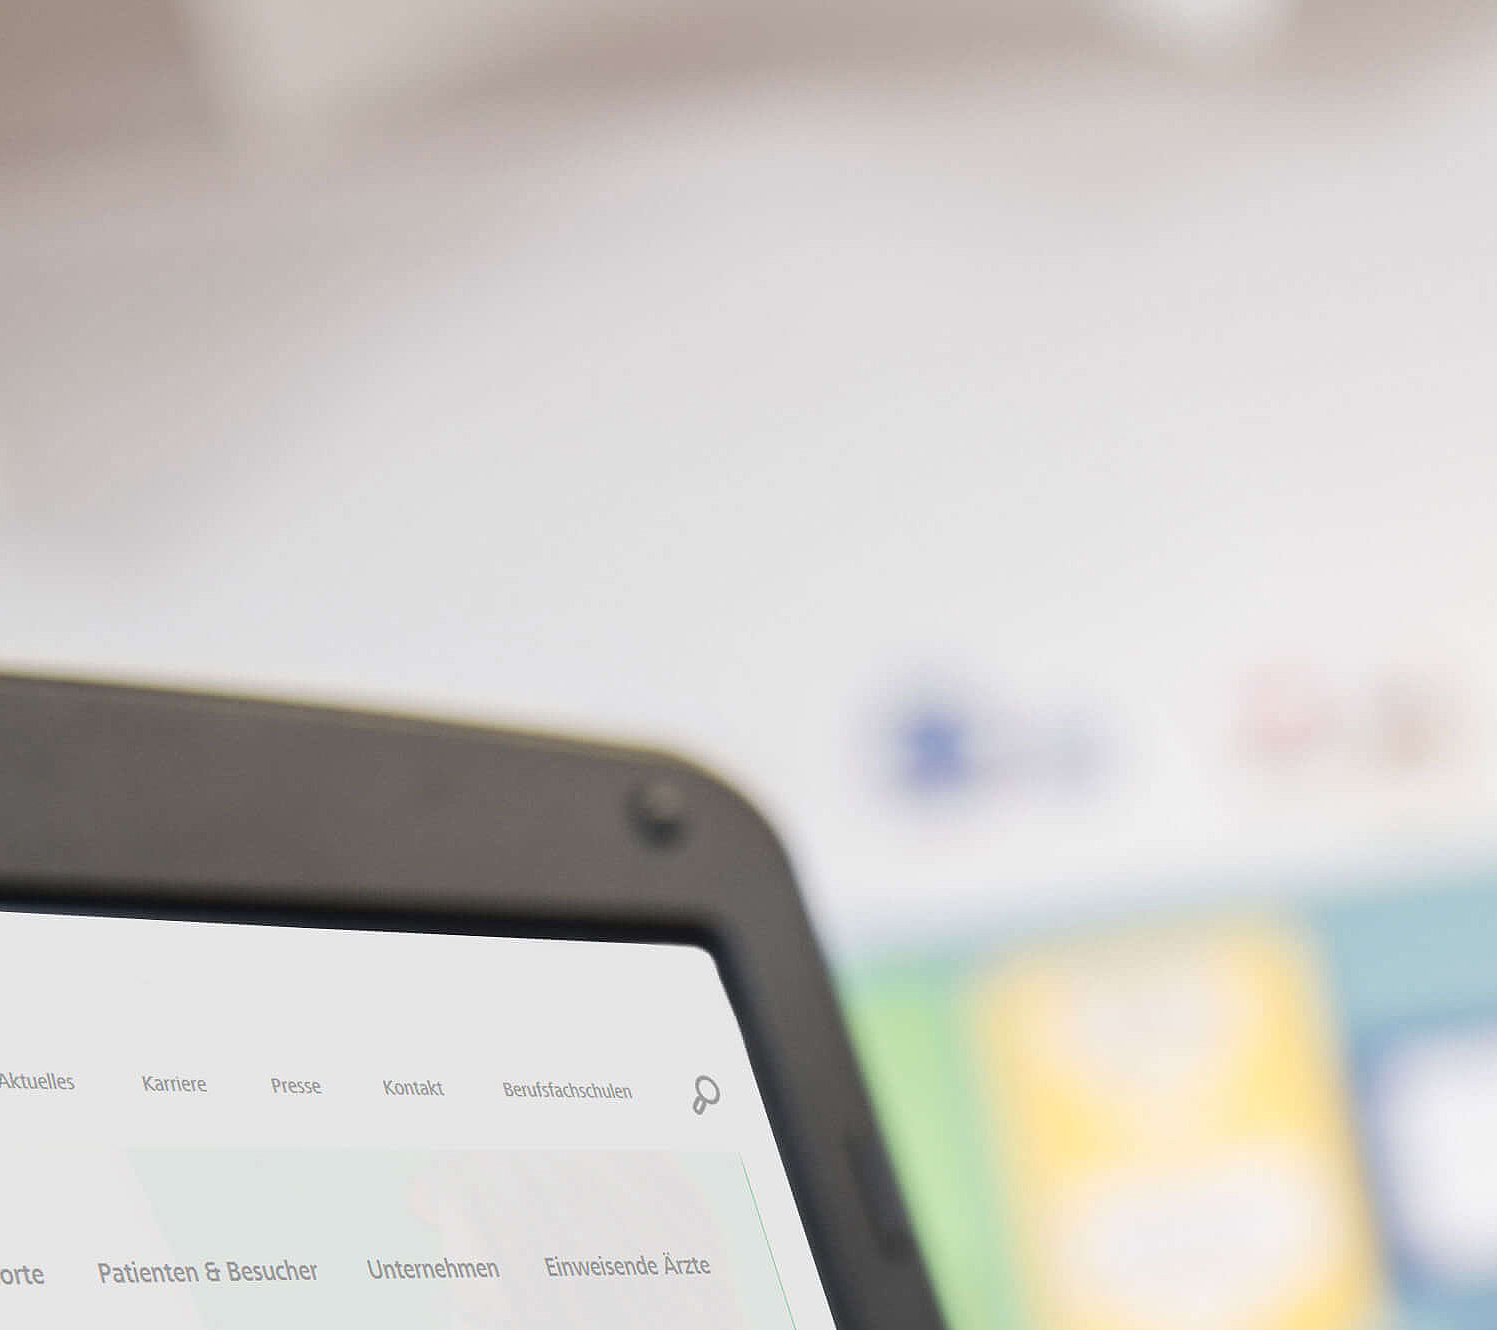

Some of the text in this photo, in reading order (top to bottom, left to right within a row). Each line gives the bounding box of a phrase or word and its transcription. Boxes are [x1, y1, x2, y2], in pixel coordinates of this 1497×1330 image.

[141, 1075, 208, 1093] Karriere
[270, 1077, 323, 1095] Presse
[382, 1079, 446, 1097] Kontakt
[502, 1081, 633, 1099] Berufsfachschulen
[97, 1259, 318, 1284] Patienten & Besucher
[366, 1257, 501, 1280] Unternehmen
[544, 1251, 712, 1277] Einweisende Ärzte
